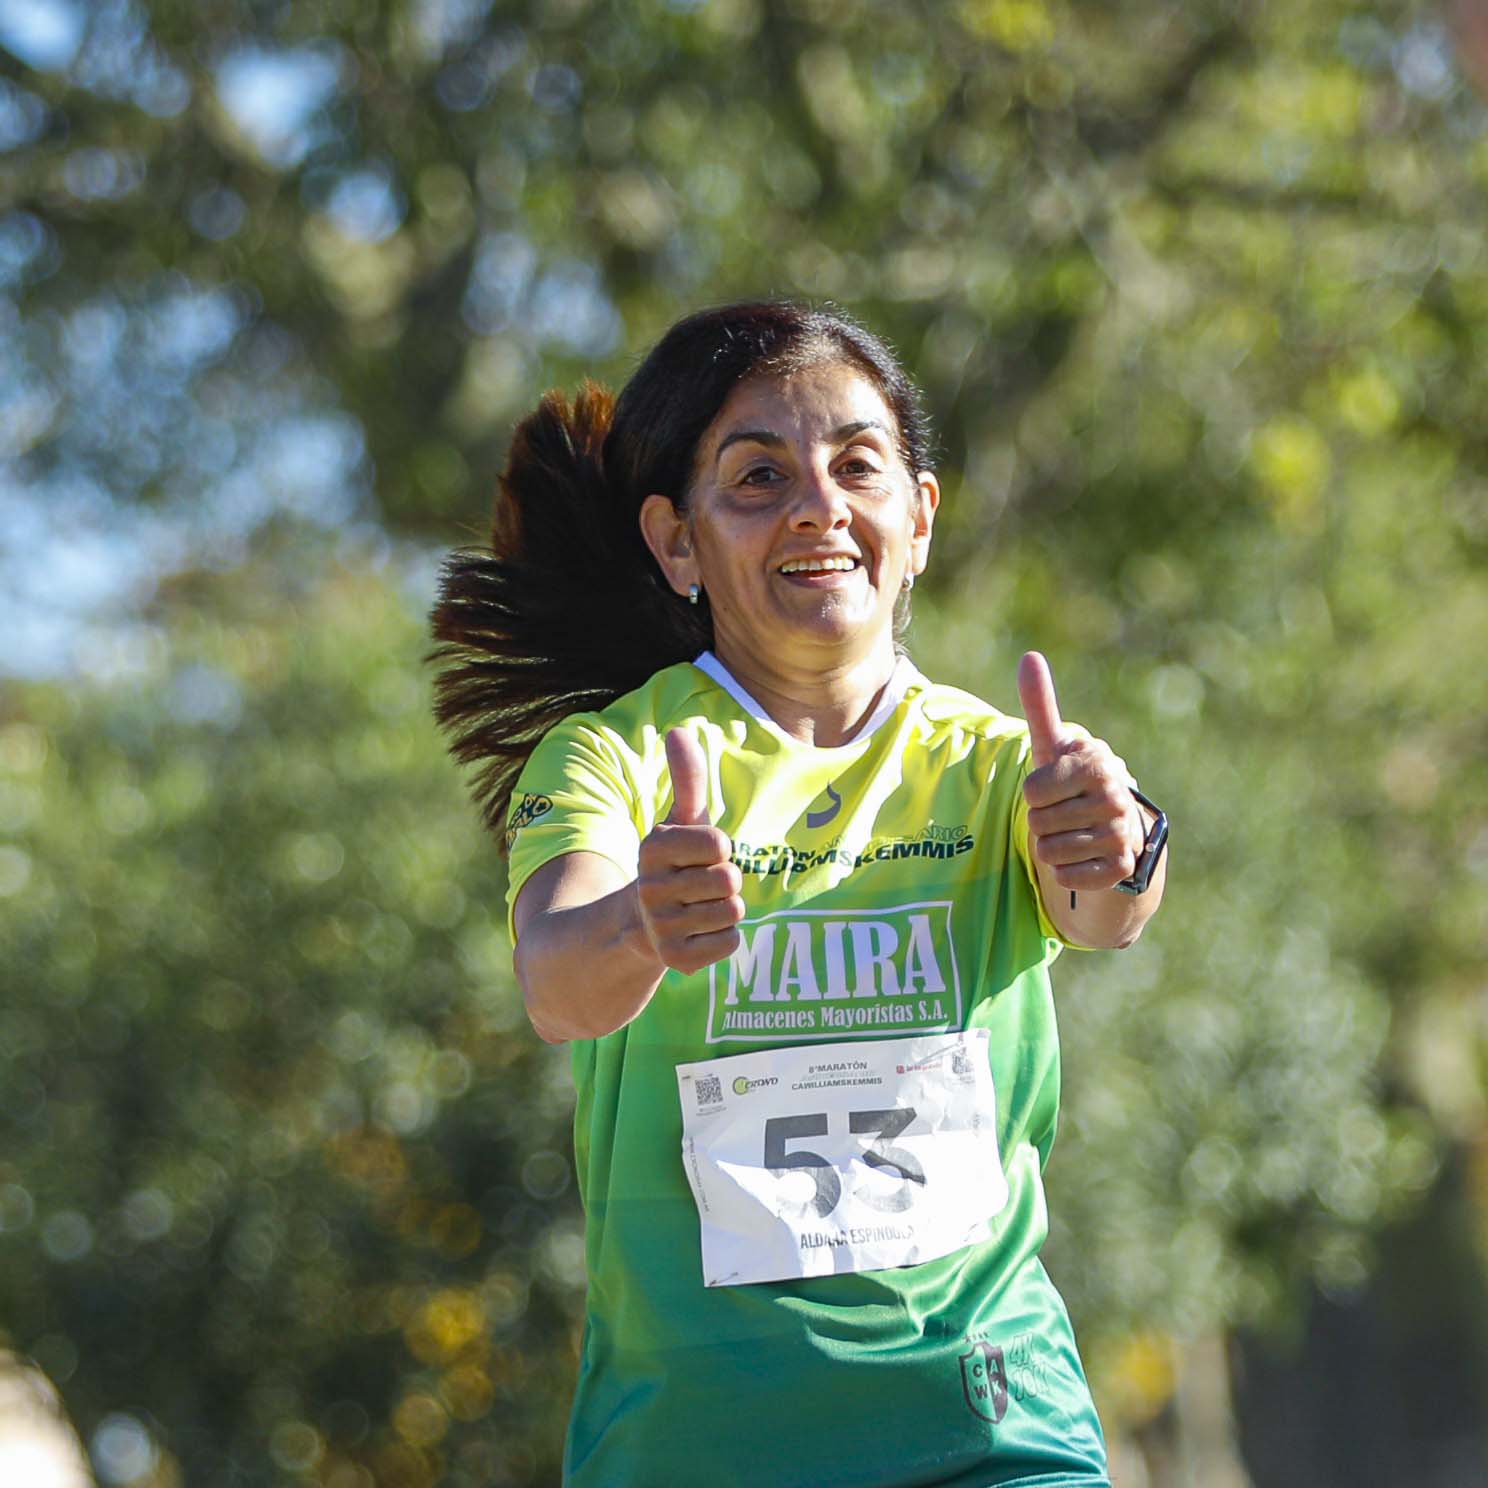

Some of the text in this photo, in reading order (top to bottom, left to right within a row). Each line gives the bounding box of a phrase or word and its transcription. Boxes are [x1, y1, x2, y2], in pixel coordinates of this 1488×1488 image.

[724, 914, 946, 1005] MAIRA
[723, 1000, 948, 1031] Almacenes Mayoristas S.A.
[765, 1107, 926, 1219] 53
[973, 1363, 983, 1378] C
[974, 1380, 1002, 1400] W K
